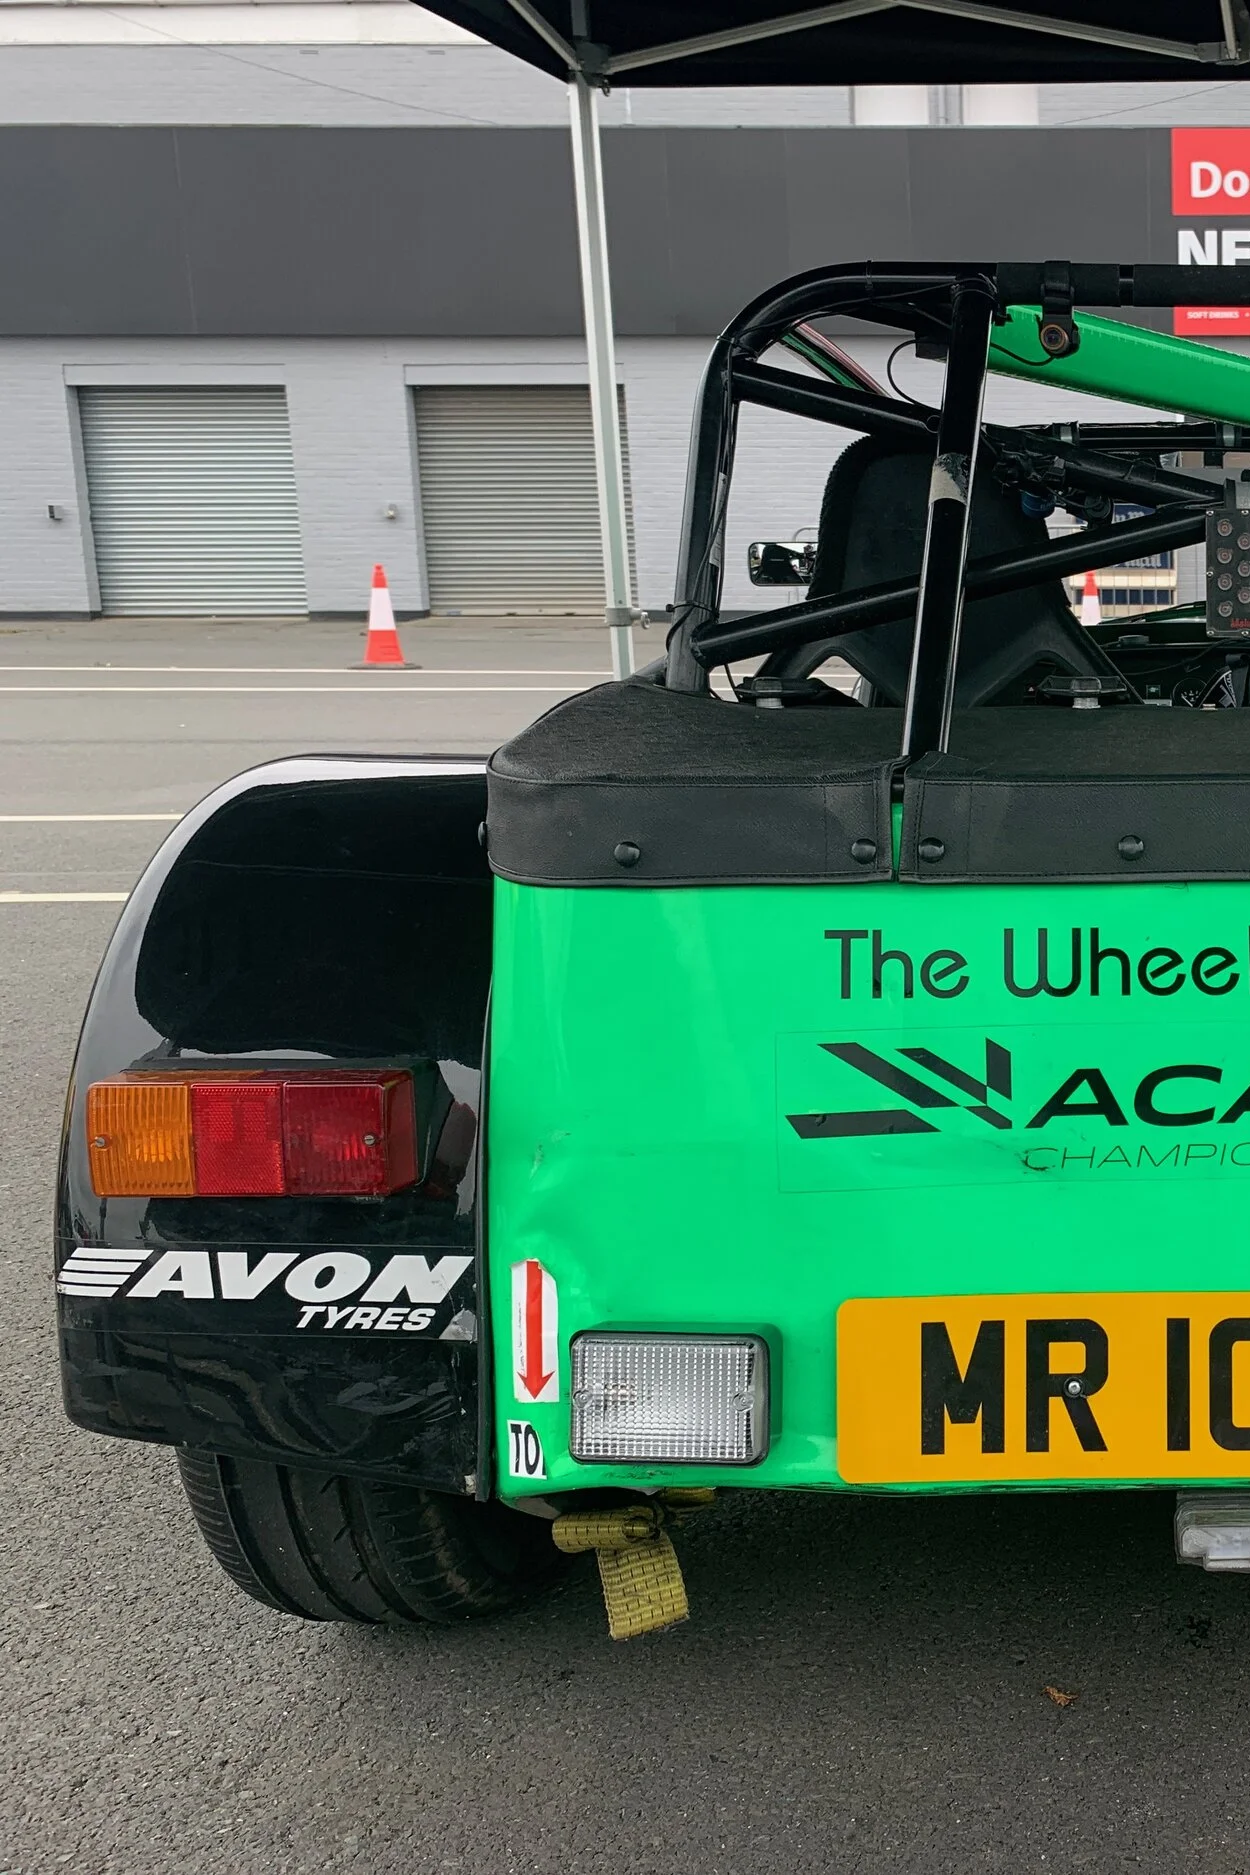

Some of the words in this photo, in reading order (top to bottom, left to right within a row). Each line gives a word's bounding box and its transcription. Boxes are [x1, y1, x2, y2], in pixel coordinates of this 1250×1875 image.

[824, 929, 970, 999] The
[127, 1250, 475, 1304] AVON
[296, 1305, 437, 1332] TYRES
[920, 1317, 1109, 1455] MR
[510, 1423, 547, 1476] TO
